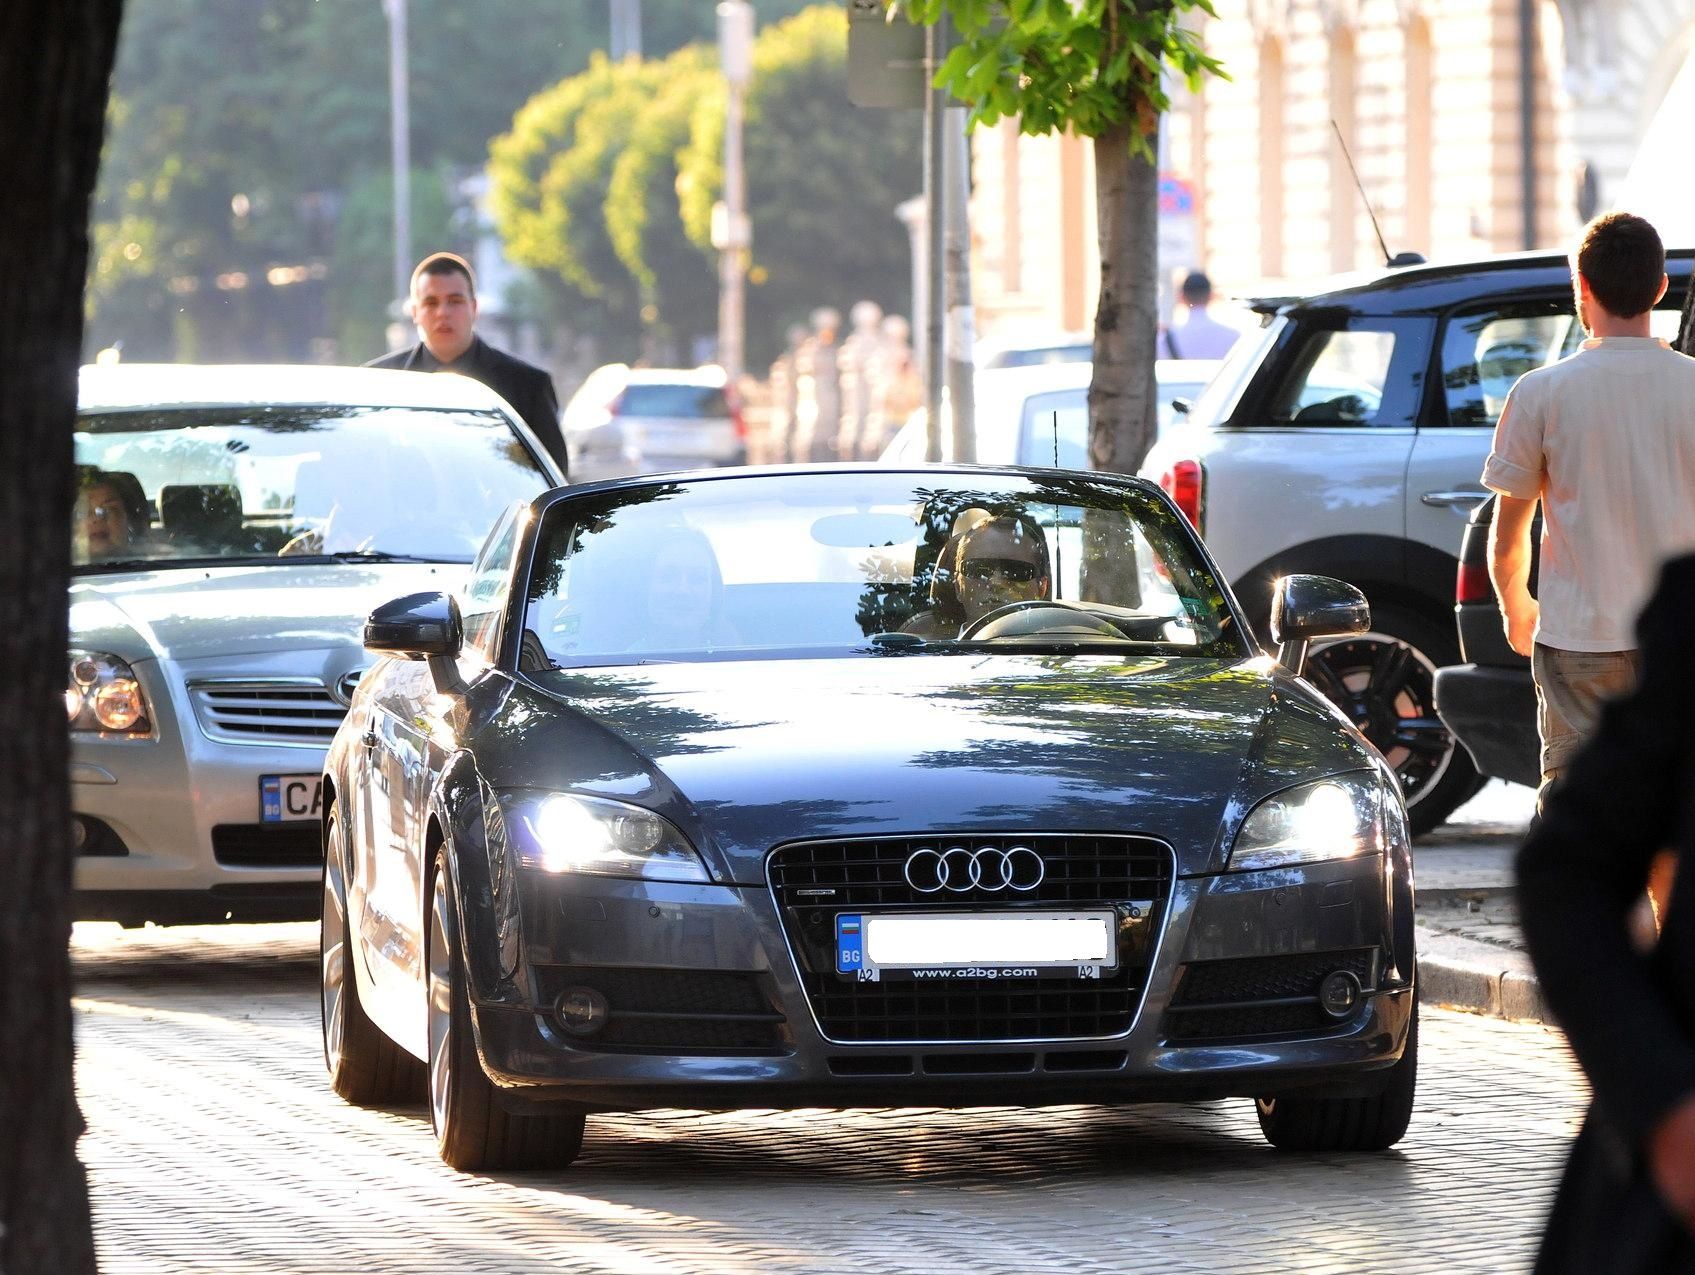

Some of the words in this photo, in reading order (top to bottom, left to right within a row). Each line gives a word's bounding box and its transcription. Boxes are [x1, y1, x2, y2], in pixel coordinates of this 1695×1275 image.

[842, 950, 860, 963] BG
[859, 968, 873, 982] A2
[912, 967, 1038, 979] www.a2bg.com
[1079, 965, 1093, 979] A2
